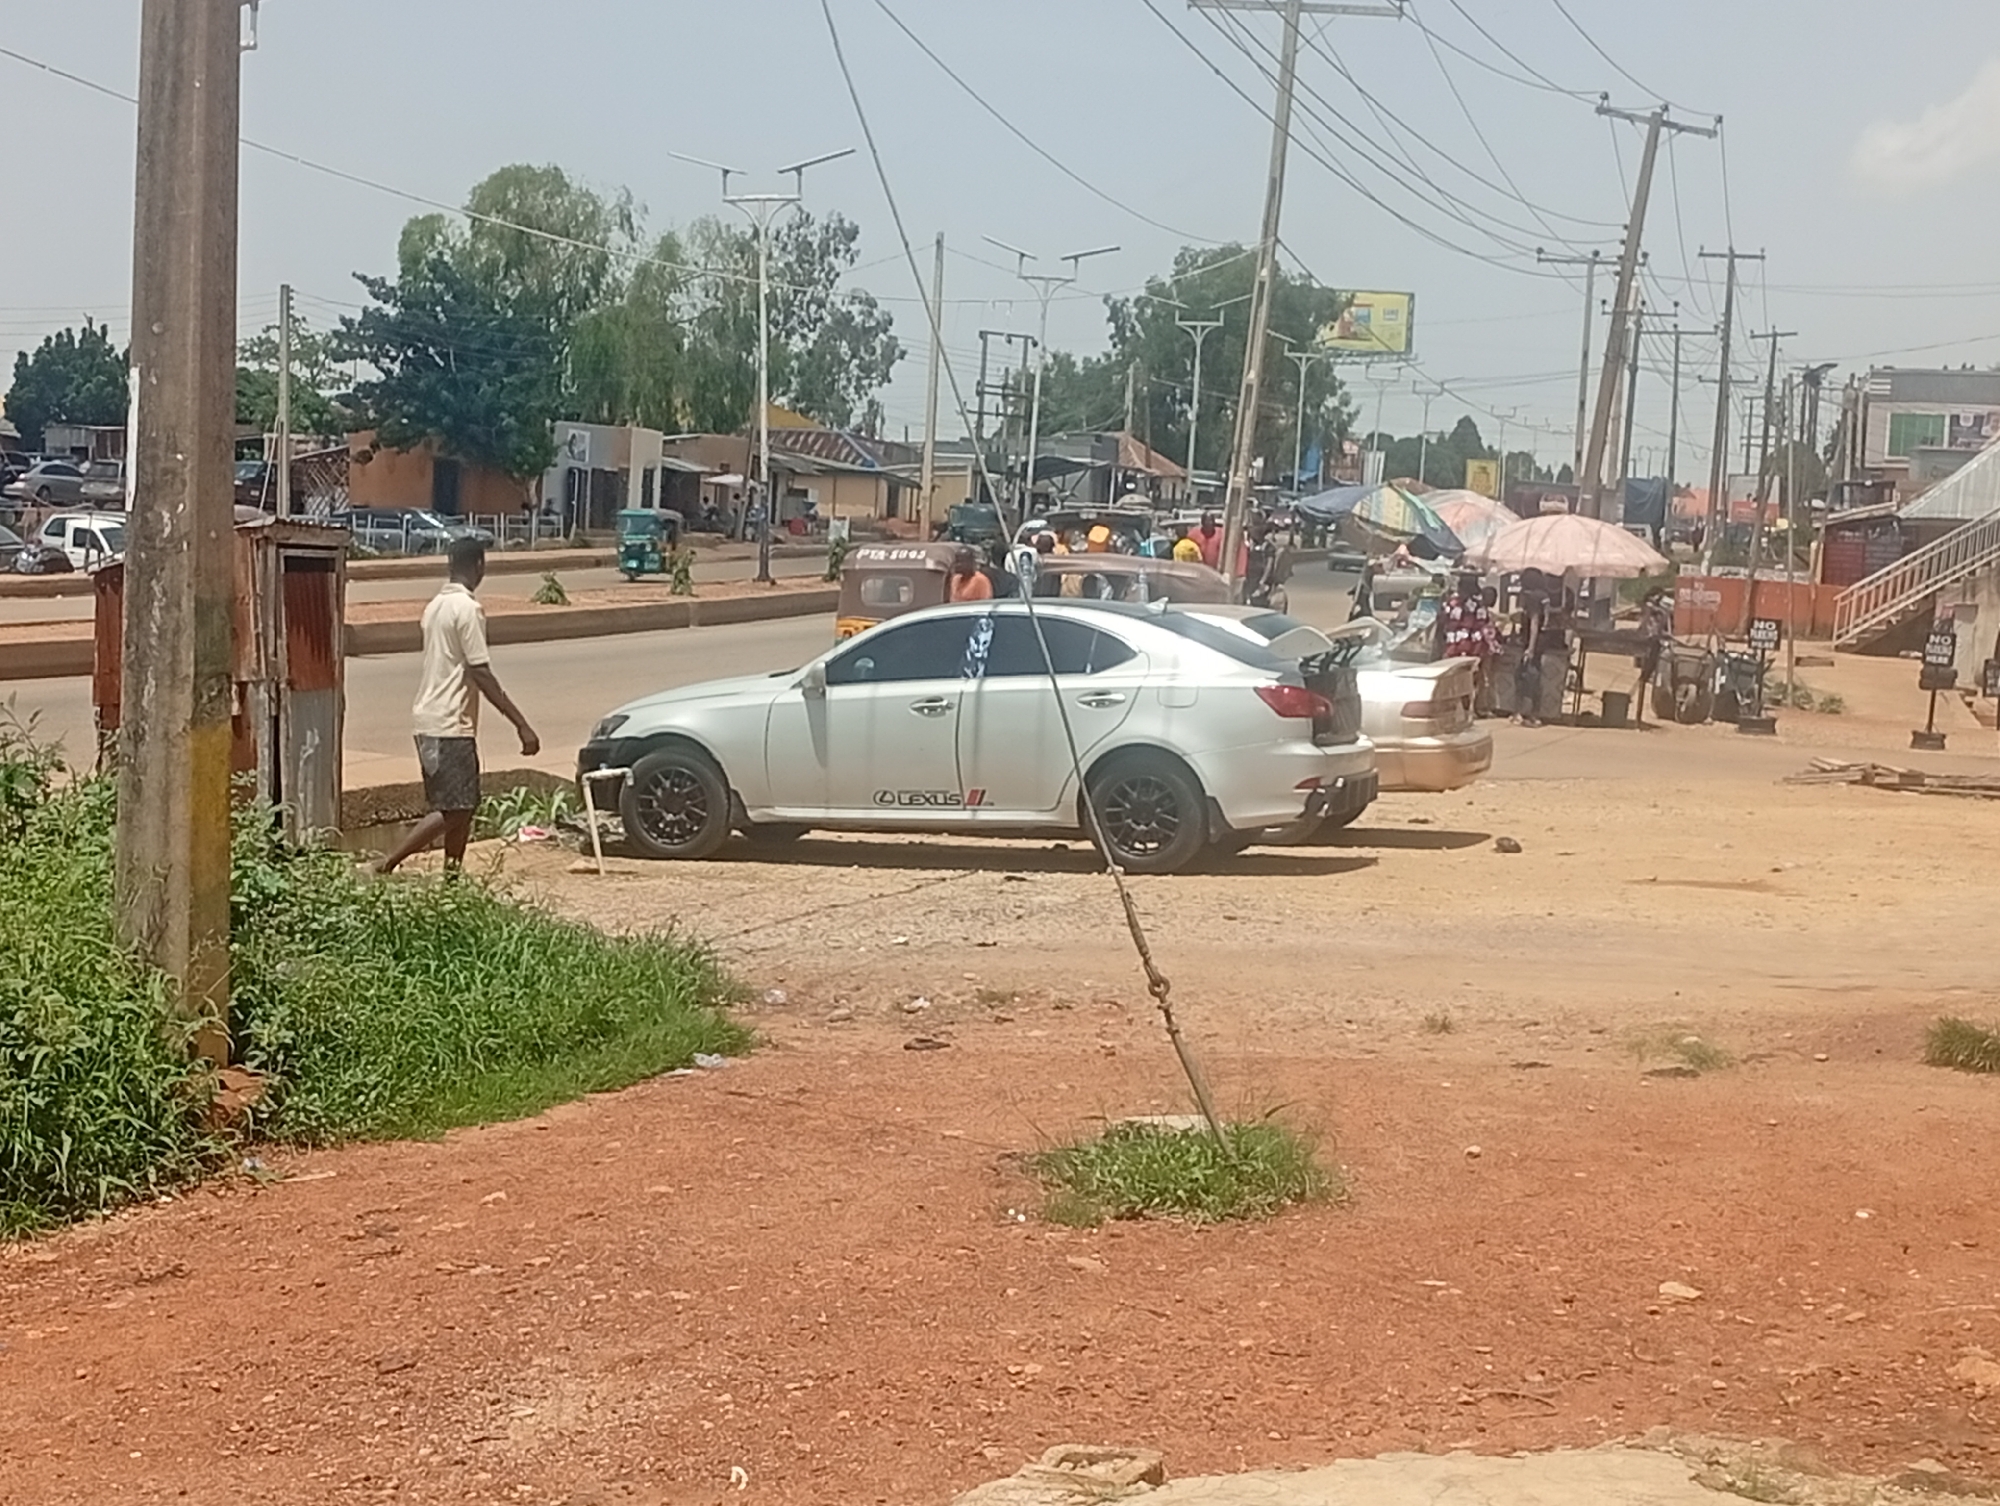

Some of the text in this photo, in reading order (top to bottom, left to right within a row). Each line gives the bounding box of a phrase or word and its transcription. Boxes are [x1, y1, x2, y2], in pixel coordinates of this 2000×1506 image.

[1753, 620, 1776, 630] NO
[1929, 634, 1951, 645] NO
[897, 790, 961, 806] LEXUS
